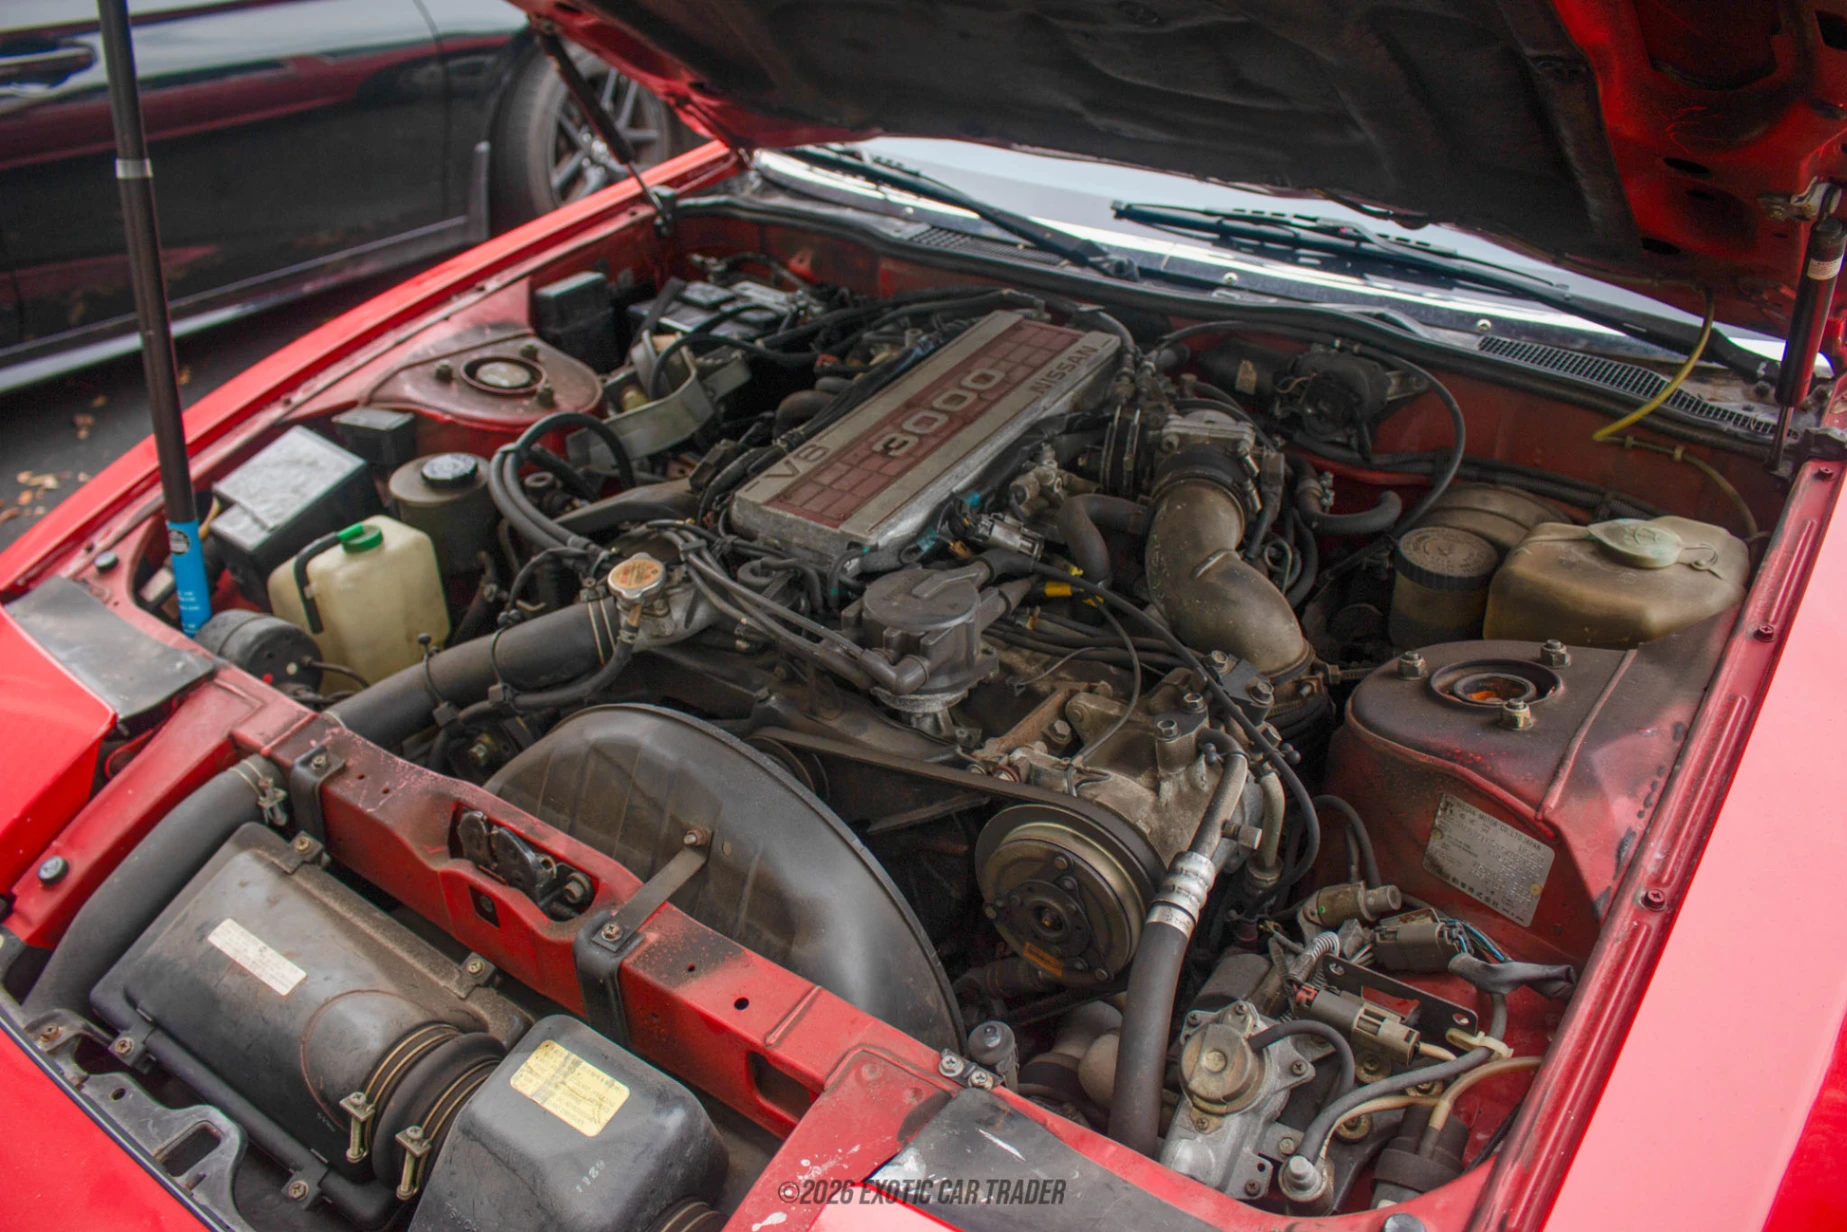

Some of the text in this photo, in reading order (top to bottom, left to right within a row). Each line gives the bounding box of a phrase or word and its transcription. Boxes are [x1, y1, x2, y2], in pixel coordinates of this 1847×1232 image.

[1031, 344, 1100, 398] NISSAN
[871, 366, 1007, 457] 3000
[765, 442, 831, 480] V6
